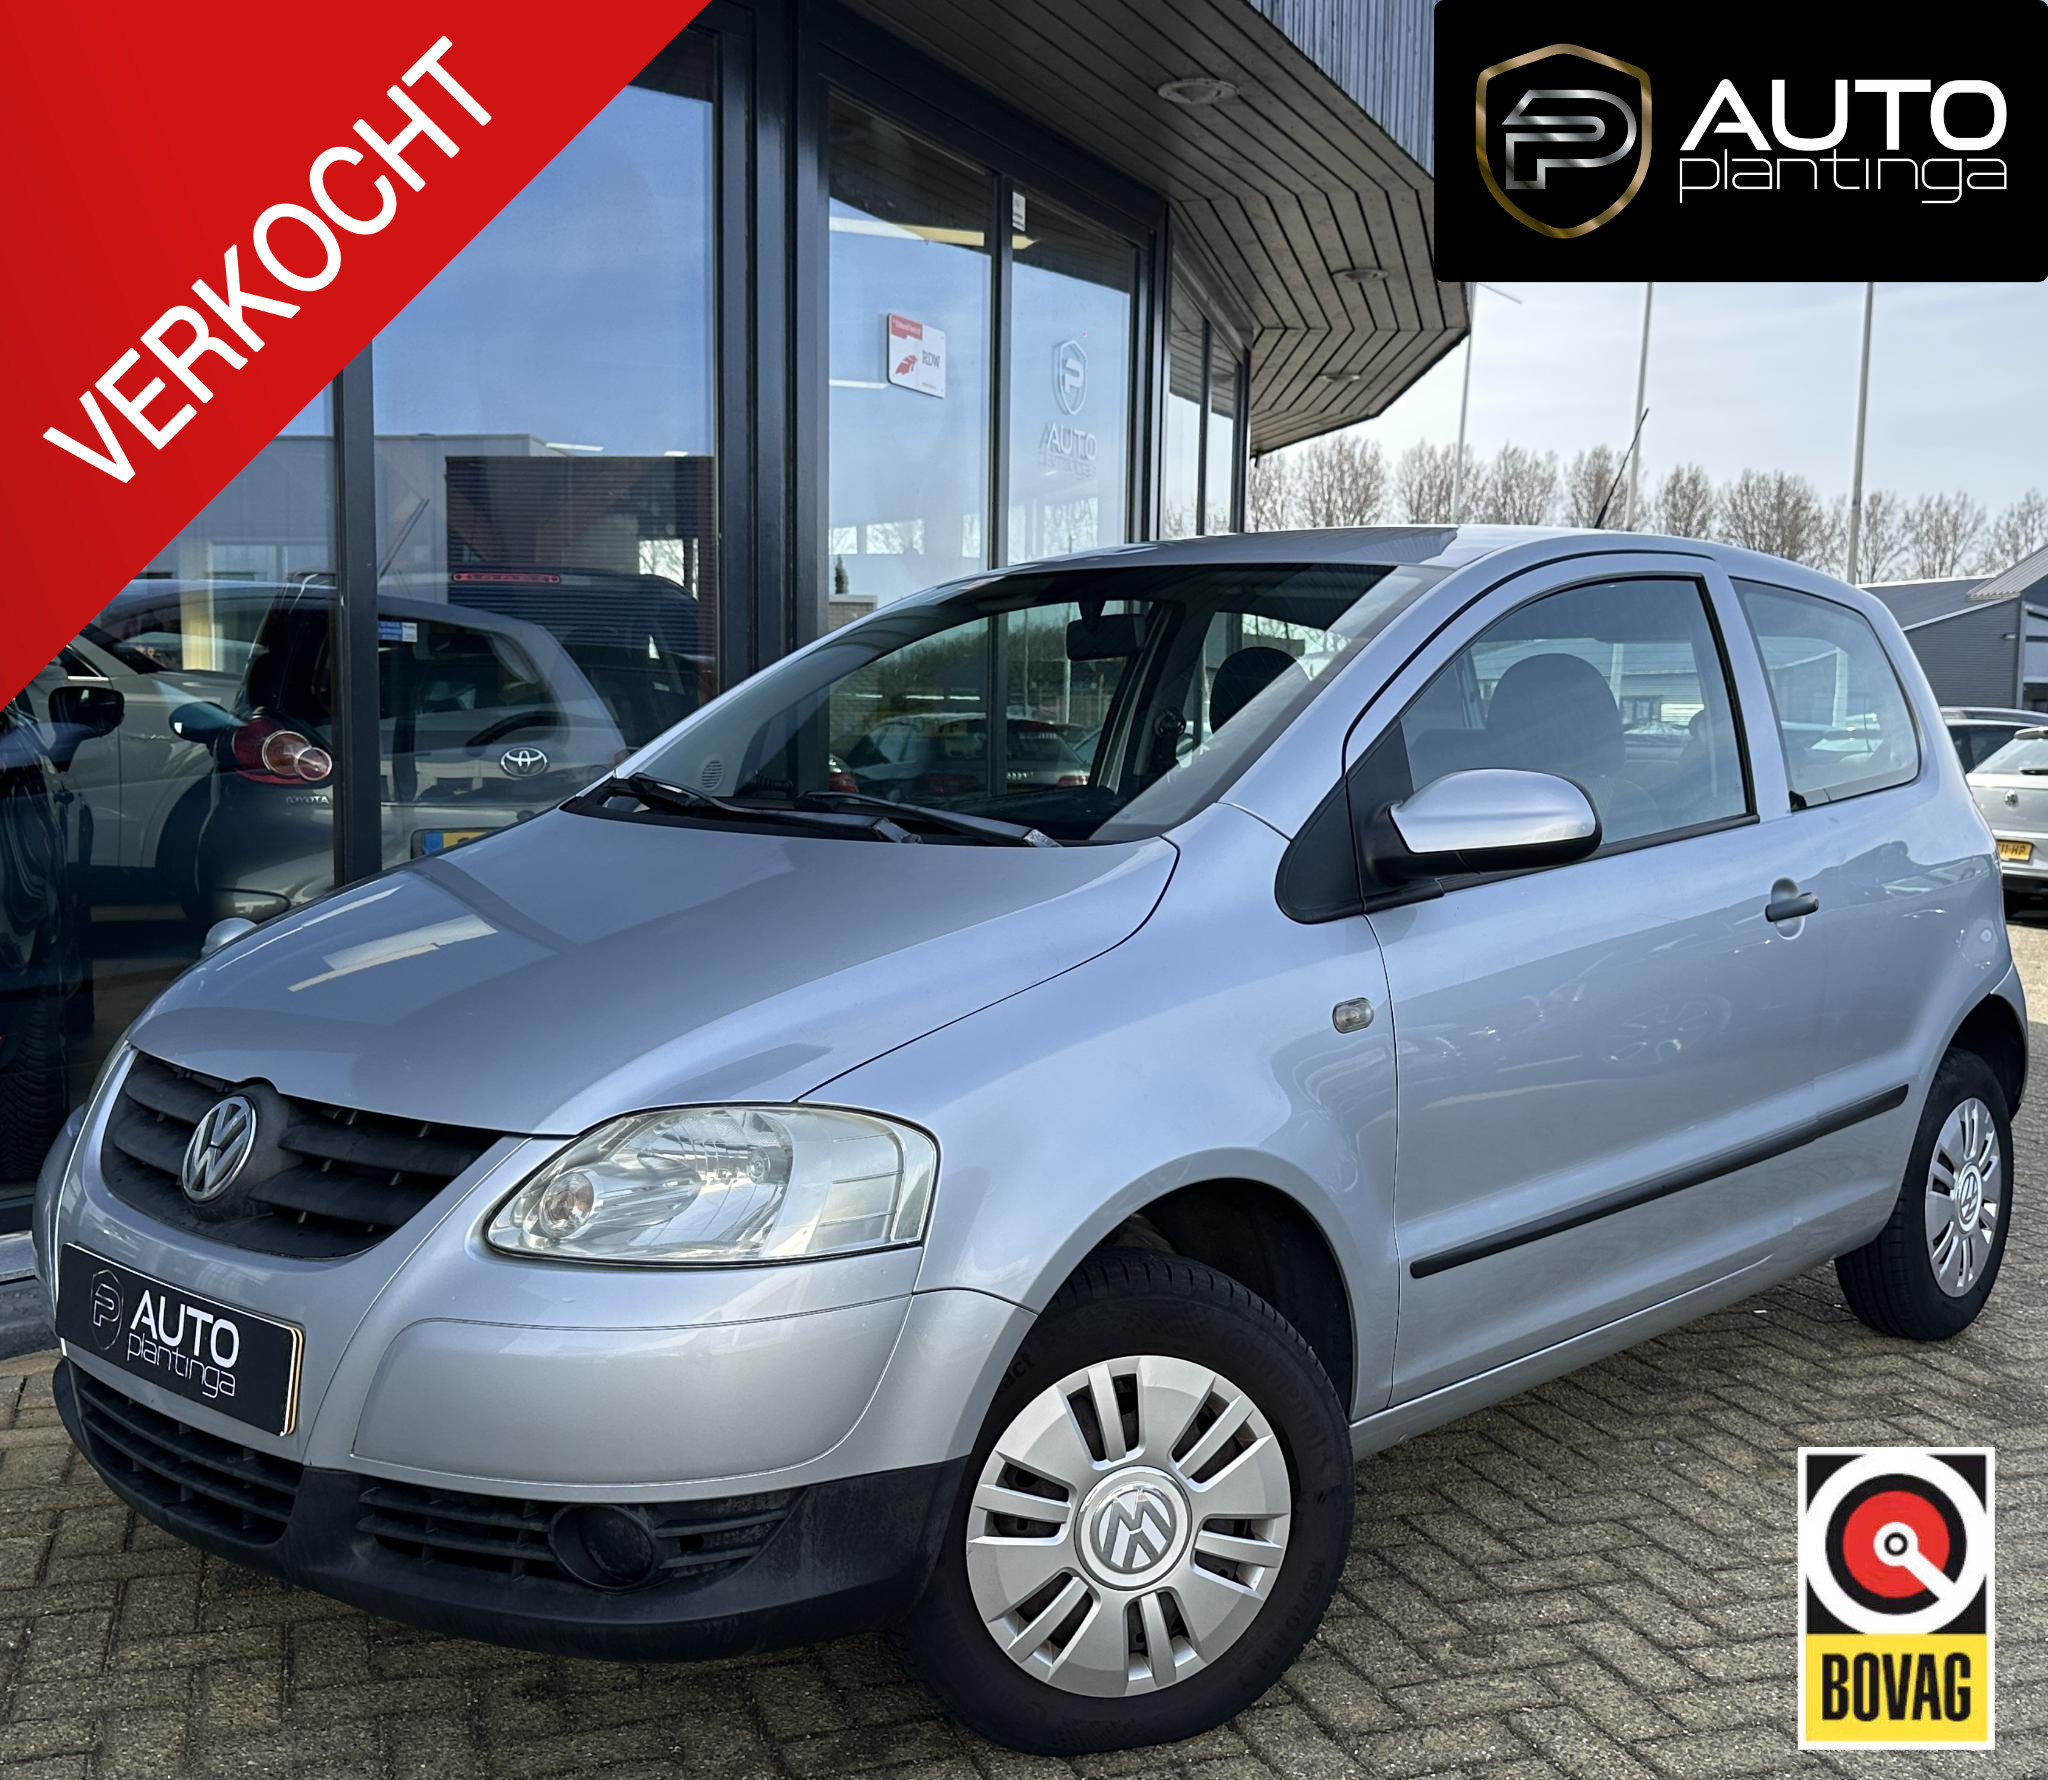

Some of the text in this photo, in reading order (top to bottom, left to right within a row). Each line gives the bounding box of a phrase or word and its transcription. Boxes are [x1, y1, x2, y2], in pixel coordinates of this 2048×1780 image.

[922, 350, 941, 368] RDW
[1047, 423, 1097, 461] AUTO
[130, 1289, 240, 1369] AUTO
[126, 1331, 236, 1399] plantinga
